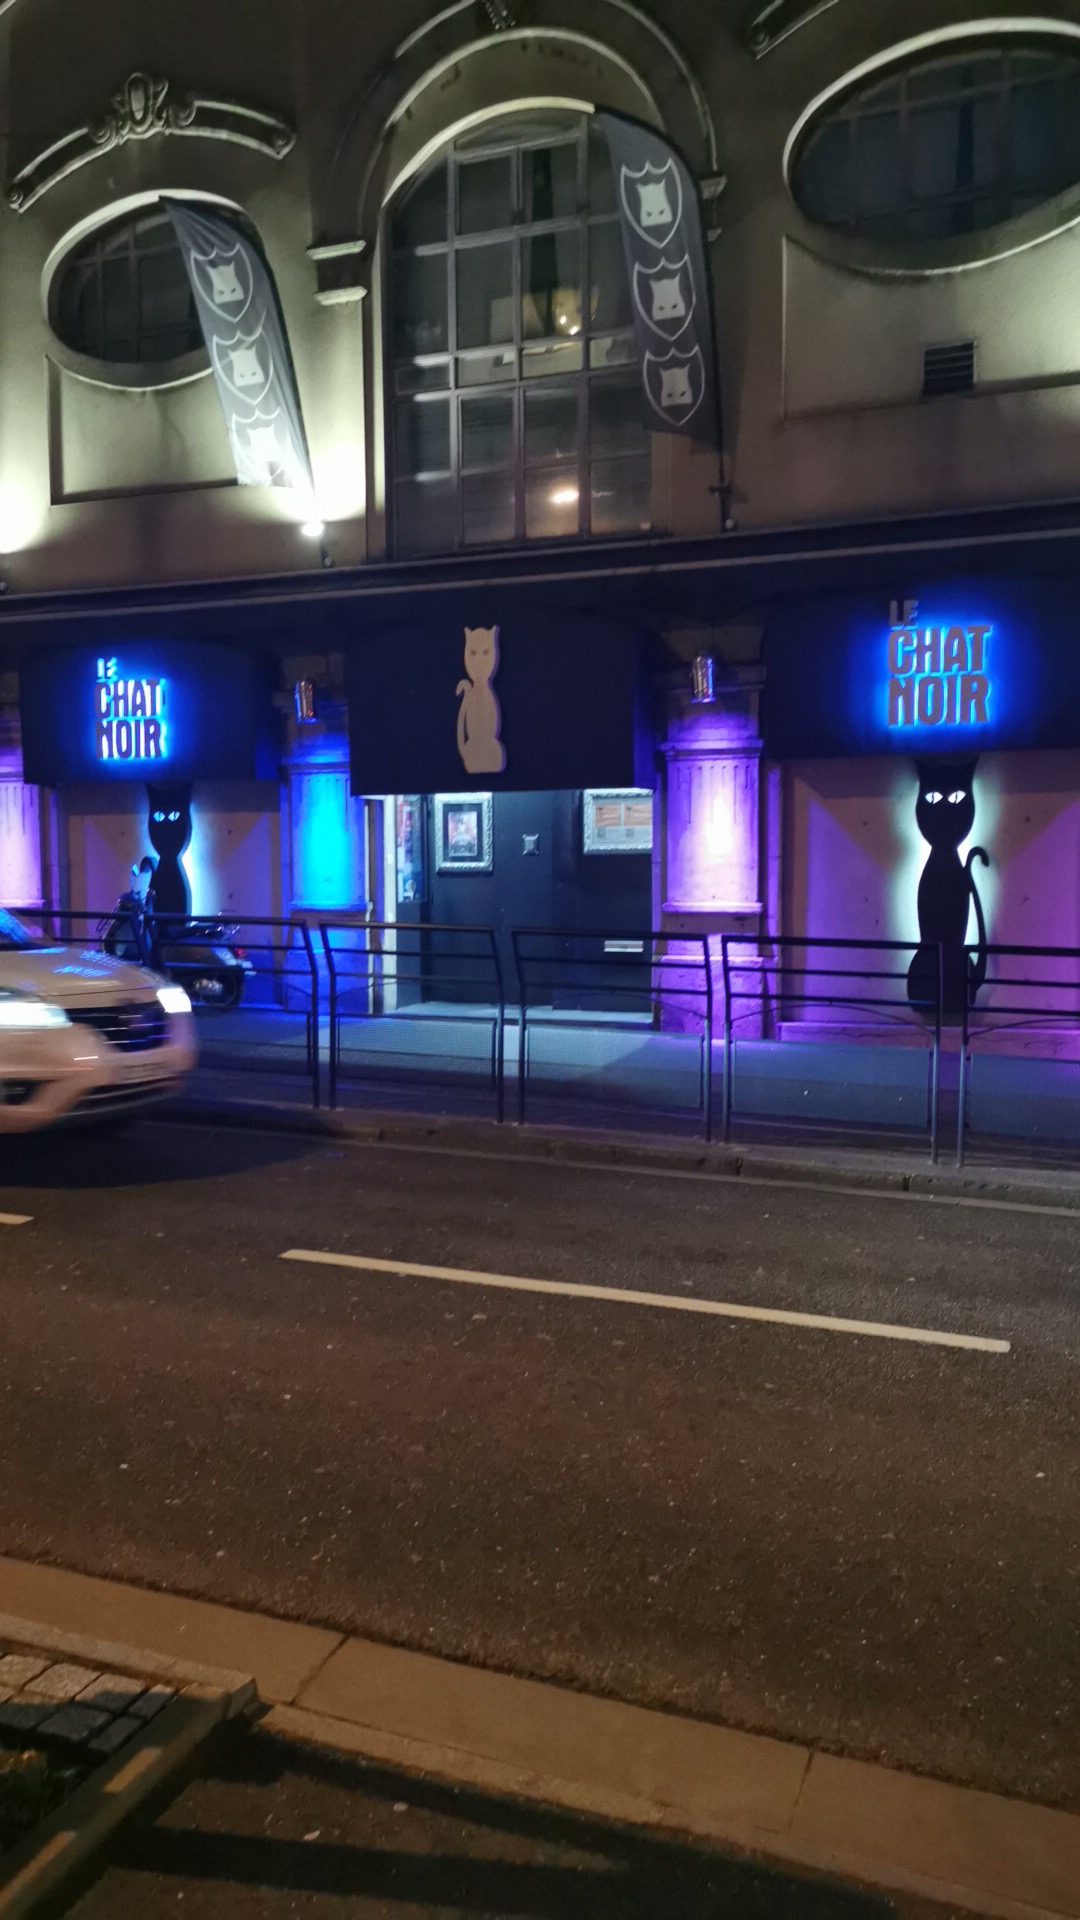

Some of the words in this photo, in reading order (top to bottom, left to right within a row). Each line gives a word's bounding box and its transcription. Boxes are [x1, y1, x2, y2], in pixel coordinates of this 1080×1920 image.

[889, 599, 919, 627] LE
[95, 657, 118, 681] LE
[888, 625, 991, 675] CHAT
[95, 678, 167, 718] CHAT
[888, 674, 991, 727] NOIR
[95, 718, 167, 760] NOIR
